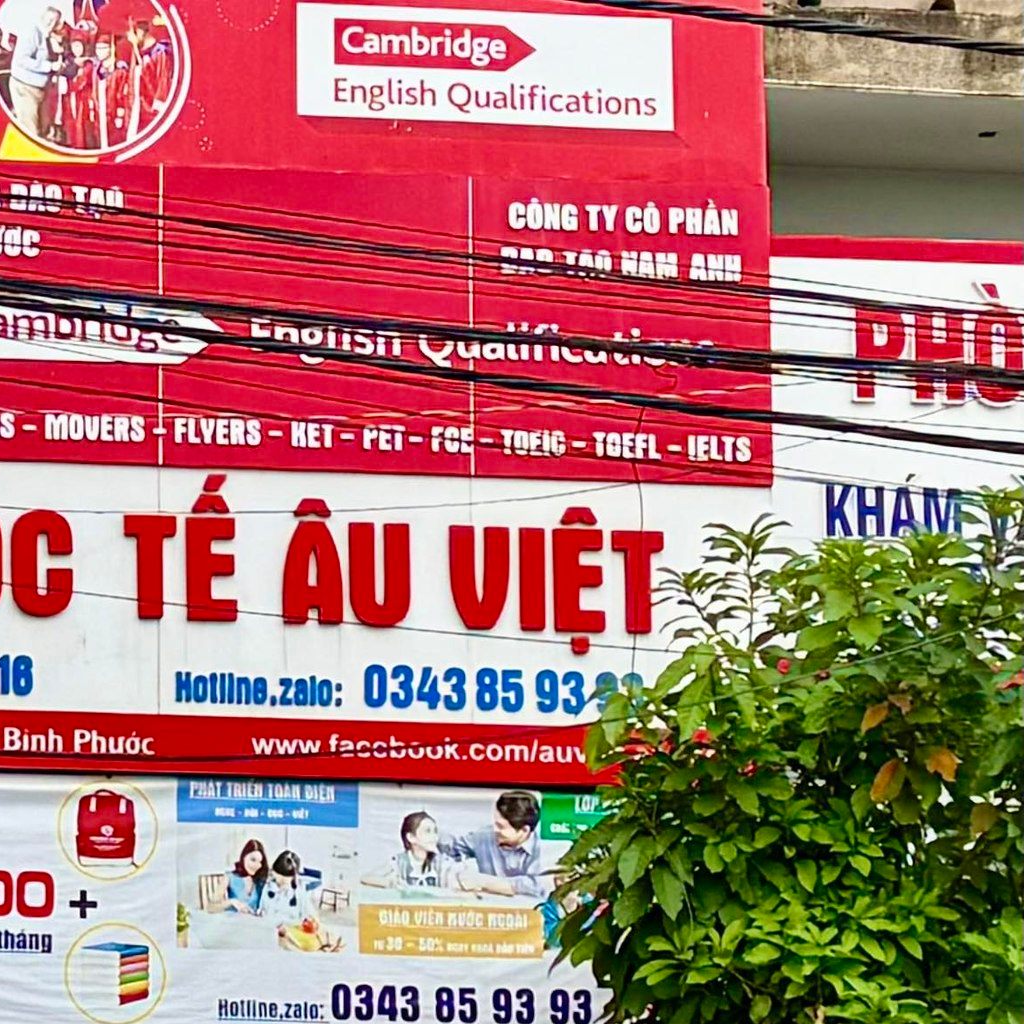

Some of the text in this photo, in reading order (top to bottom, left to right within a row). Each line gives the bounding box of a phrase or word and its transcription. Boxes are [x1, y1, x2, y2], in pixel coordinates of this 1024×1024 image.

[341, 26, 507, 66] Cambridge
[333, 78, 658, 117] English Qualifications
[508, 198, 578, 231] CÔNG
[585, 205, 619, 231] TY
[621, 250, 679, 279] NAM
[688, 253, 742, 282] ANH
[45, 414, 146, 442] MOVERS
[174, 417, 262, 446] FLYERS
[291, 421, 335, 449] KET
[363, 424, 405, 451] PET
[593, 432, 662, 460] TOEFL
[687, 436, 752, 463] IELTS
[826, 474, 963, 539] KHÁM
[123, 473, 240, 623] TẾ
[282, 498, 410, 626] ÂU
[449, 506, 664, 656] VIỆT
[364, 664, 468, 710] 0343
[475, 668, 522, 713] 85
[535, 669, 585, 715] 93
[74, 727, 155, 758] Phước
[331, 983, 421, 1022] 0343
[435, 986, 477, 1024] 85
[492, 987, 536, 1024] 93
